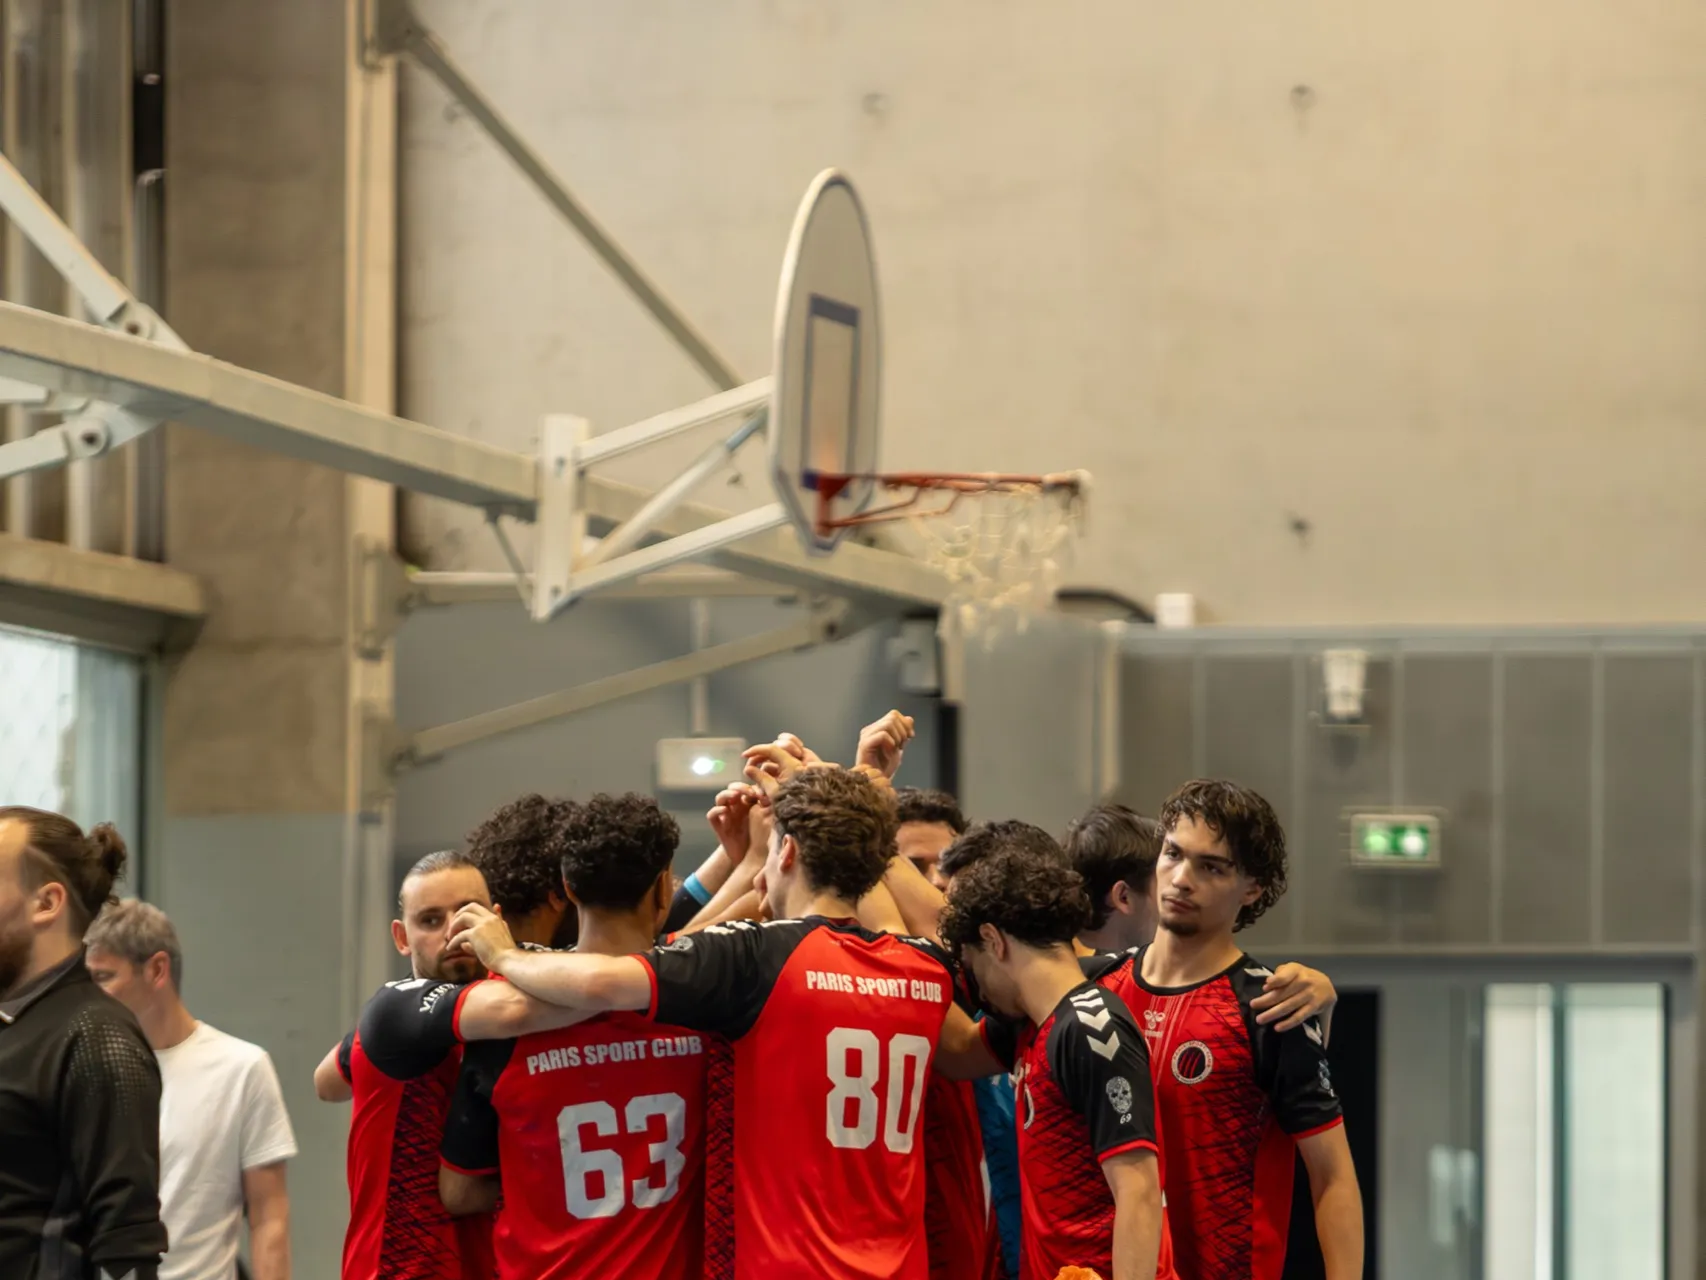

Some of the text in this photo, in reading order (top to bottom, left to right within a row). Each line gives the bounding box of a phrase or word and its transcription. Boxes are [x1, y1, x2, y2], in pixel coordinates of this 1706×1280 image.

[806, 971, 943, 1003] PARIS SPORT CLUB
[526, 1035, 702, 1075] PARIS SPORT CLUB
[826, 1026, 931, 1155] 80
[556, 1092, 686, 1220] 63
